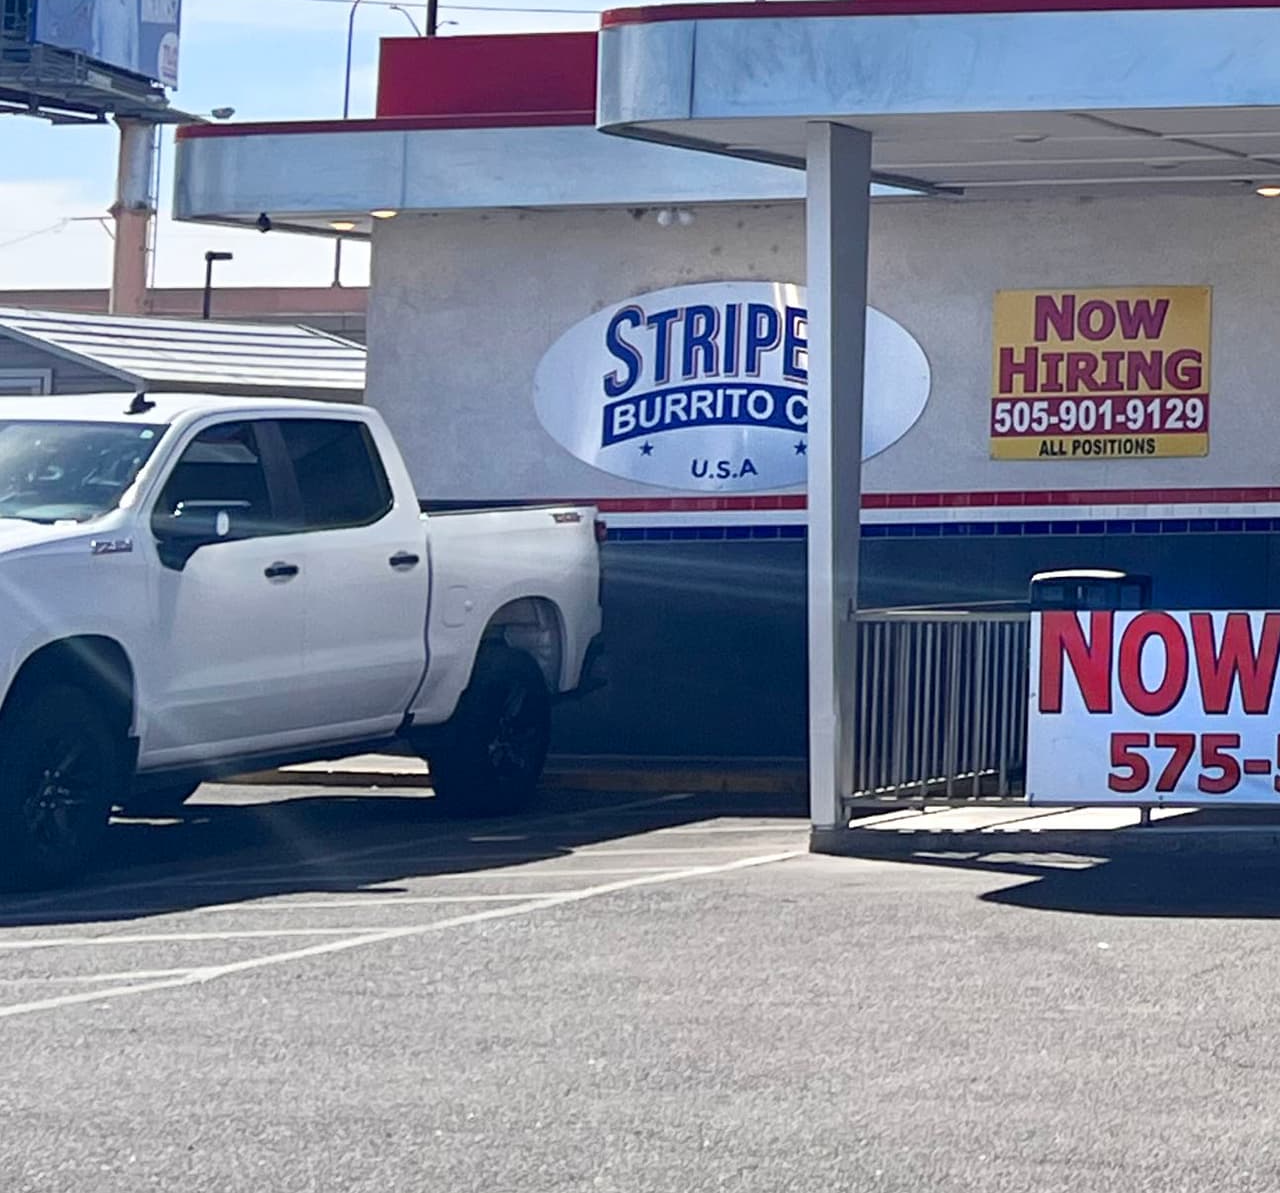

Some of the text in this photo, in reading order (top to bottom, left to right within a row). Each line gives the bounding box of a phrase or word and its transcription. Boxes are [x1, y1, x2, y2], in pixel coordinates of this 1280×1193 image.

[1034, 295, 1170, 341] NOW
[603, 303, 808, 398] STRIPE
[1000, 347, 1202, 393] HIRING
[613, 389, 774, 436] BURRITO
[994, 398, 1204, 434] 505-901-9129
[691, 458, 759, 479] U.S.A
[1039, 438, 1156, 457] ALL POSITIONS
